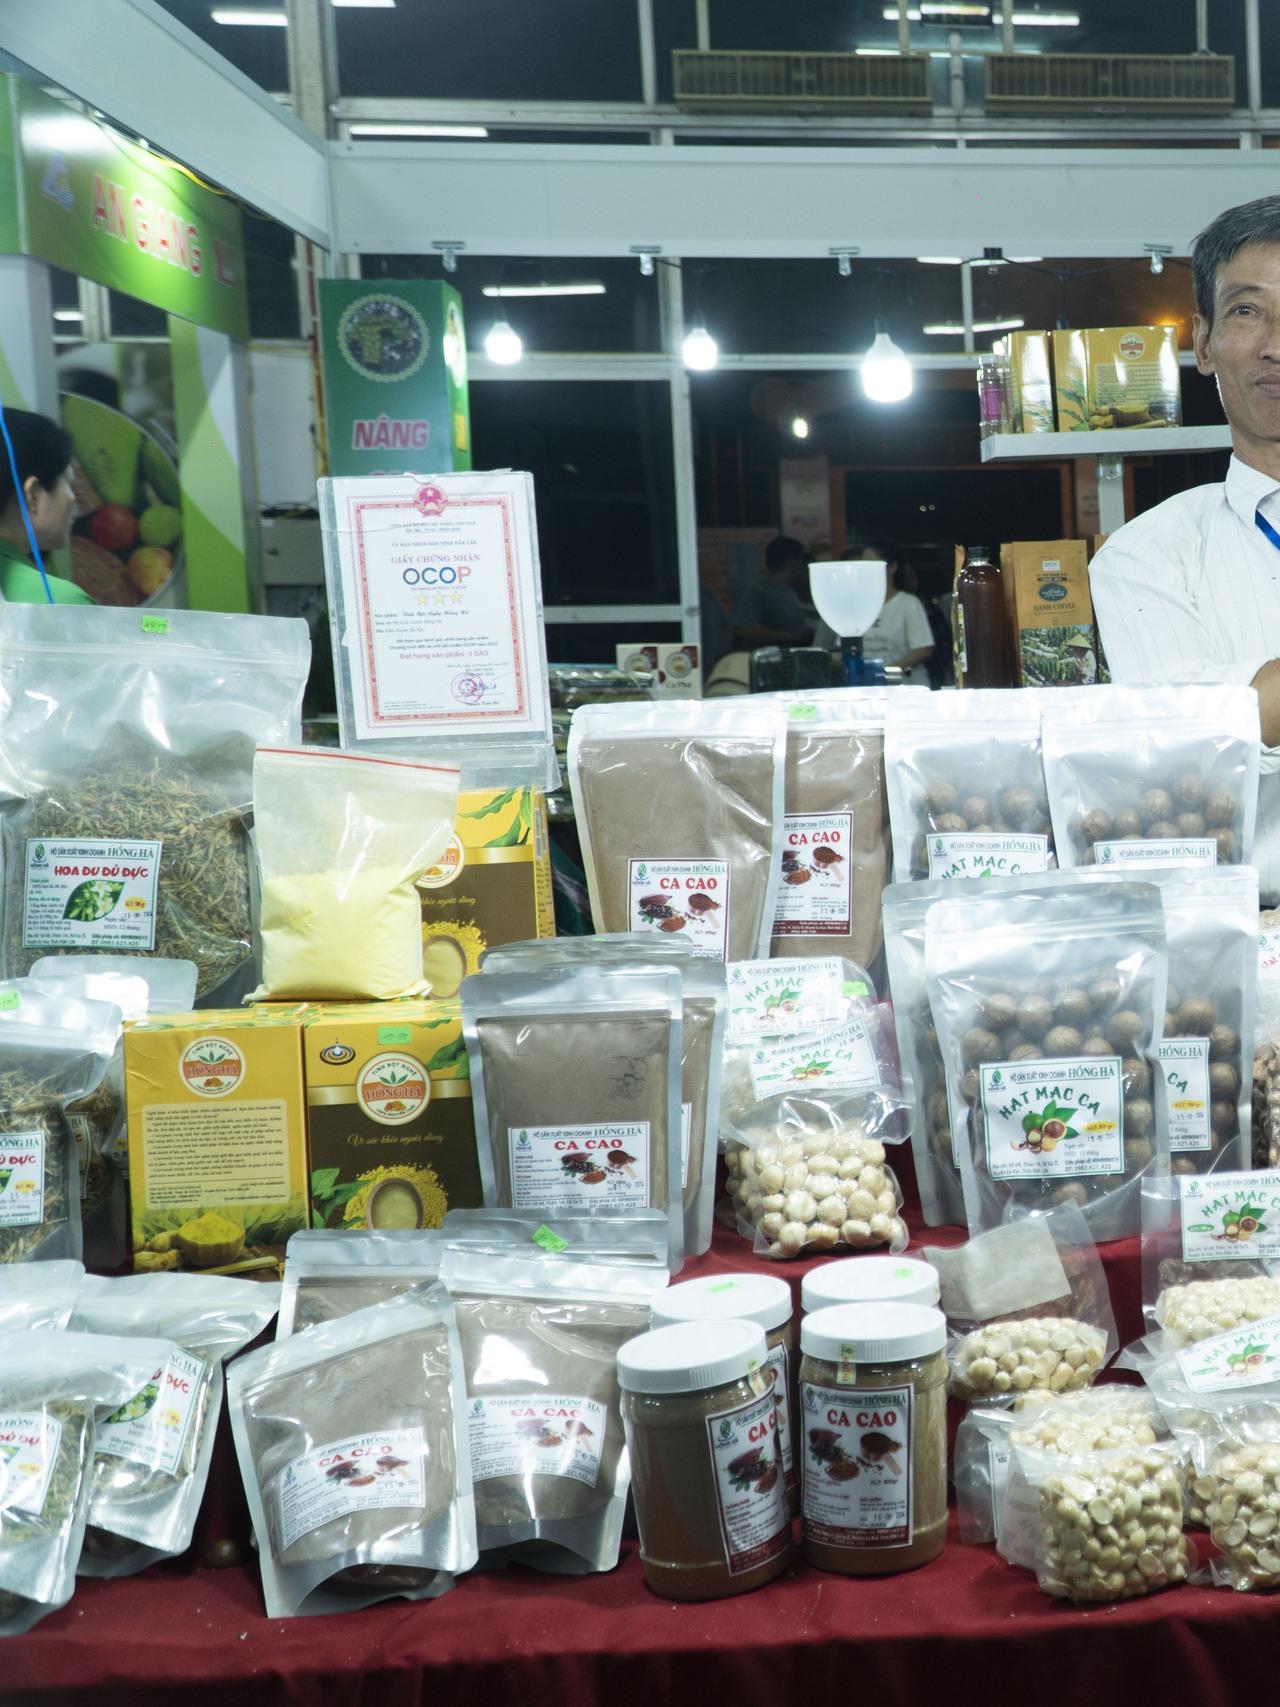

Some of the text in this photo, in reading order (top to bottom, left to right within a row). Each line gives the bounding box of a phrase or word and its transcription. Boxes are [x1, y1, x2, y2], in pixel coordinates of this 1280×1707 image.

[93, 175, 128, 243] AN
[130, 192, 202, 277] GIANG
[352, 413, 430, 450] NÂNG
[391, 554, 413, 564] GIẤY
[403, 566, 472, 585] OCOP
[788, 831, 841, 846] CA CAO
[139, 847, 154, 858] HÀ
[54, 864, 149, 880] HOA ĐU ĐỦ ĐỰC
[659, 877, 718, 890] CA CAO
[1100, 1065, 1115, 1077] HÀ
[1167, 1072, 1189, 1094] CA
[404, 1085, 422, 1098] HÀ
[999, 1086, 1100, 1120] HẠT MAC CA
[554, 1138, 623, 1151] CA CAO
[1235, 1190, 1267, 1203] MAC
[511, 1407, 582, 1419] CA CAO
[827, 1409, 897, 1428] CA CAO
[748, 1423, 768, 1443] CA
[319, 1445, 393, 1468] CA CAO
